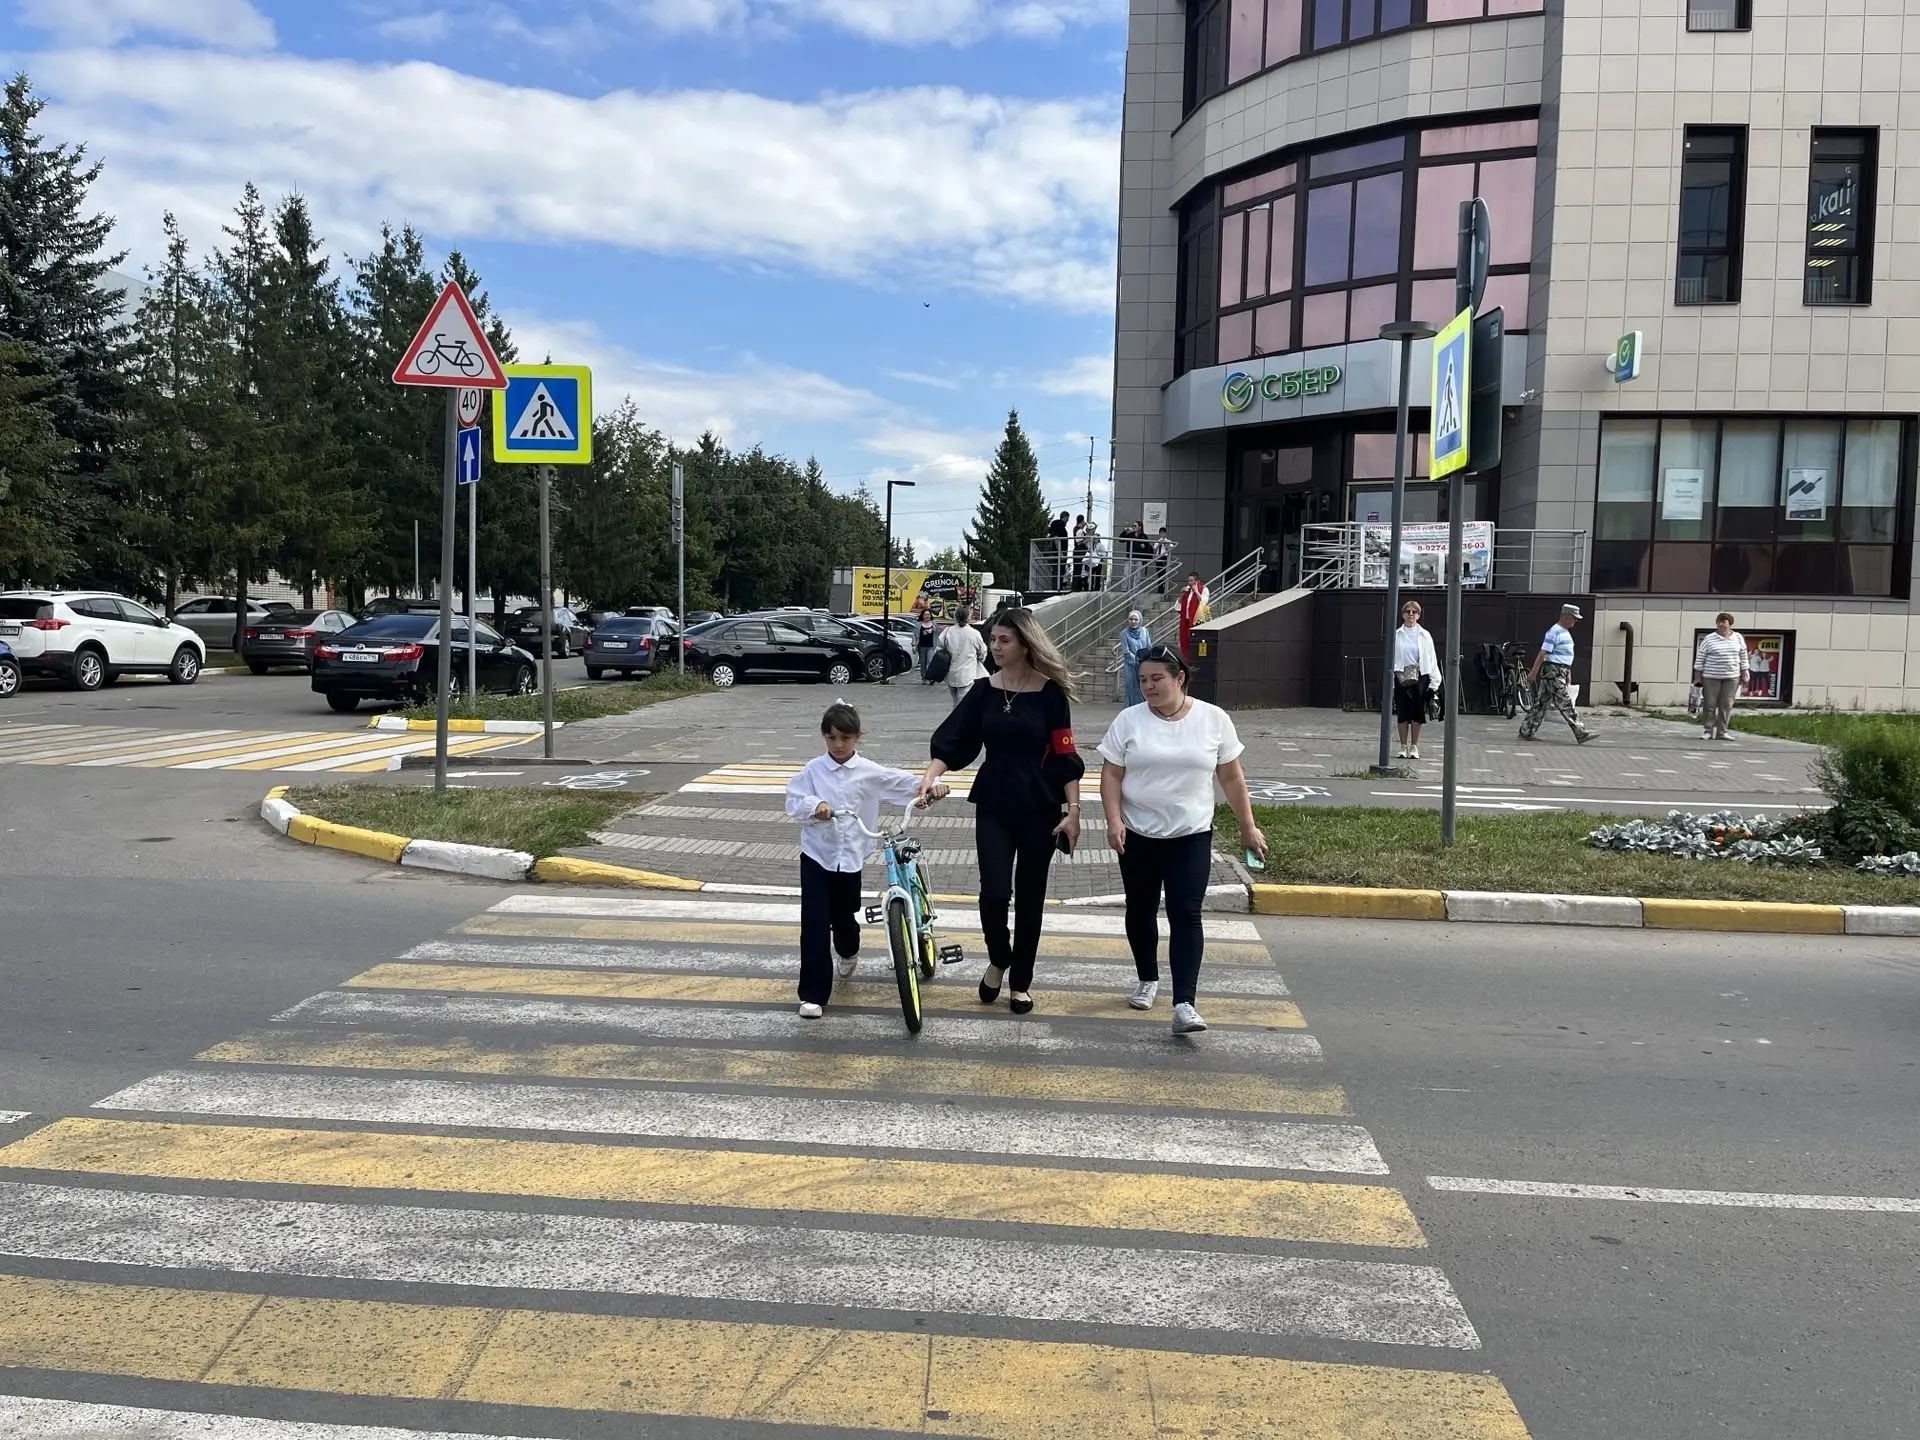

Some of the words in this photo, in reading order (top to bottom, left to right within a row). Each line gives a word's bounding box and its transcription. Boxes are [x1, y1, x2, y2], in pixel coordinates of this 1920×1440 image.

[1260, 364, 1340, 400] СБЕР
[462, 390, 477, 411] 40
[924, 578, 960, 589] GREENOLA
